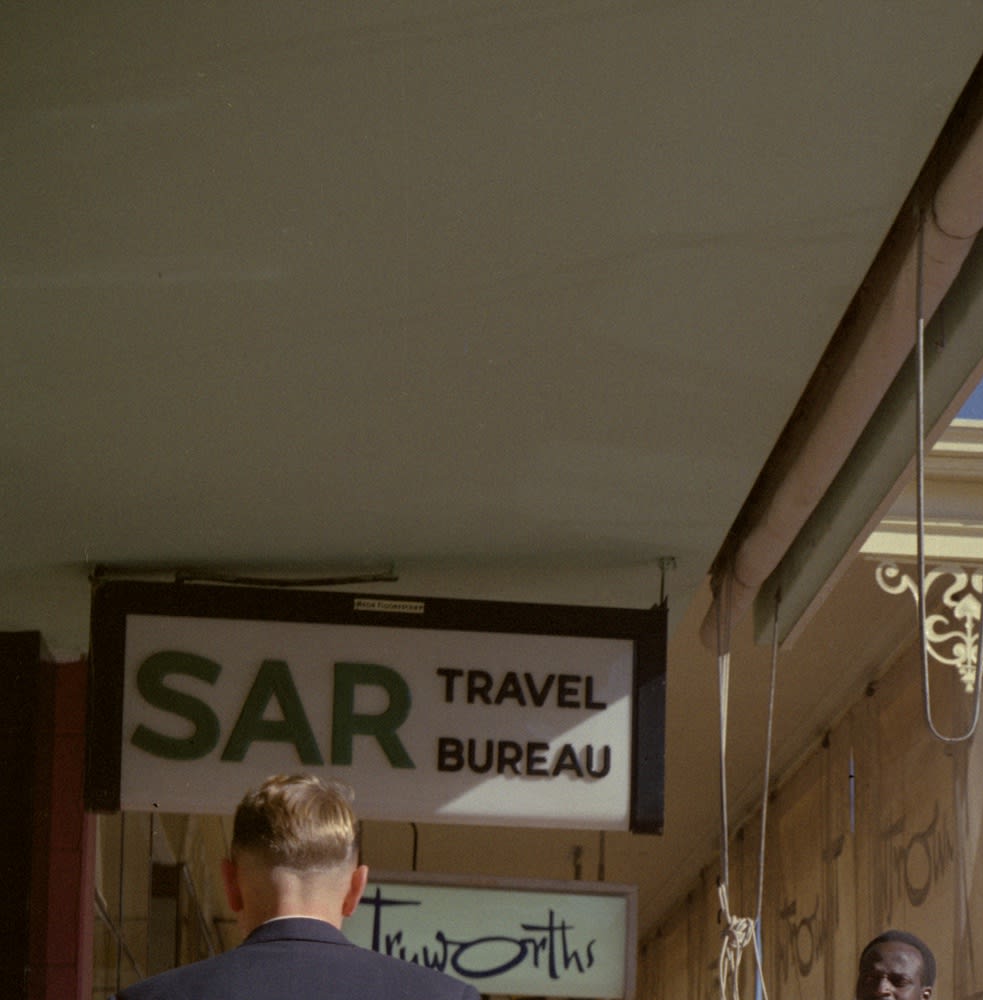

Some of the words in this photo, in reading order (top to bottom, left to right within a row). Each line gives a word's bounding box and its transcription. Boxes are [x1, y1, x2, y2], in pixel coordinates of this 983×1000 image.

[130, 650, 416, 769] SAR
[436, 667, 607, 710] TRAVEL
[436, 736, 612, 779] BUREAU
